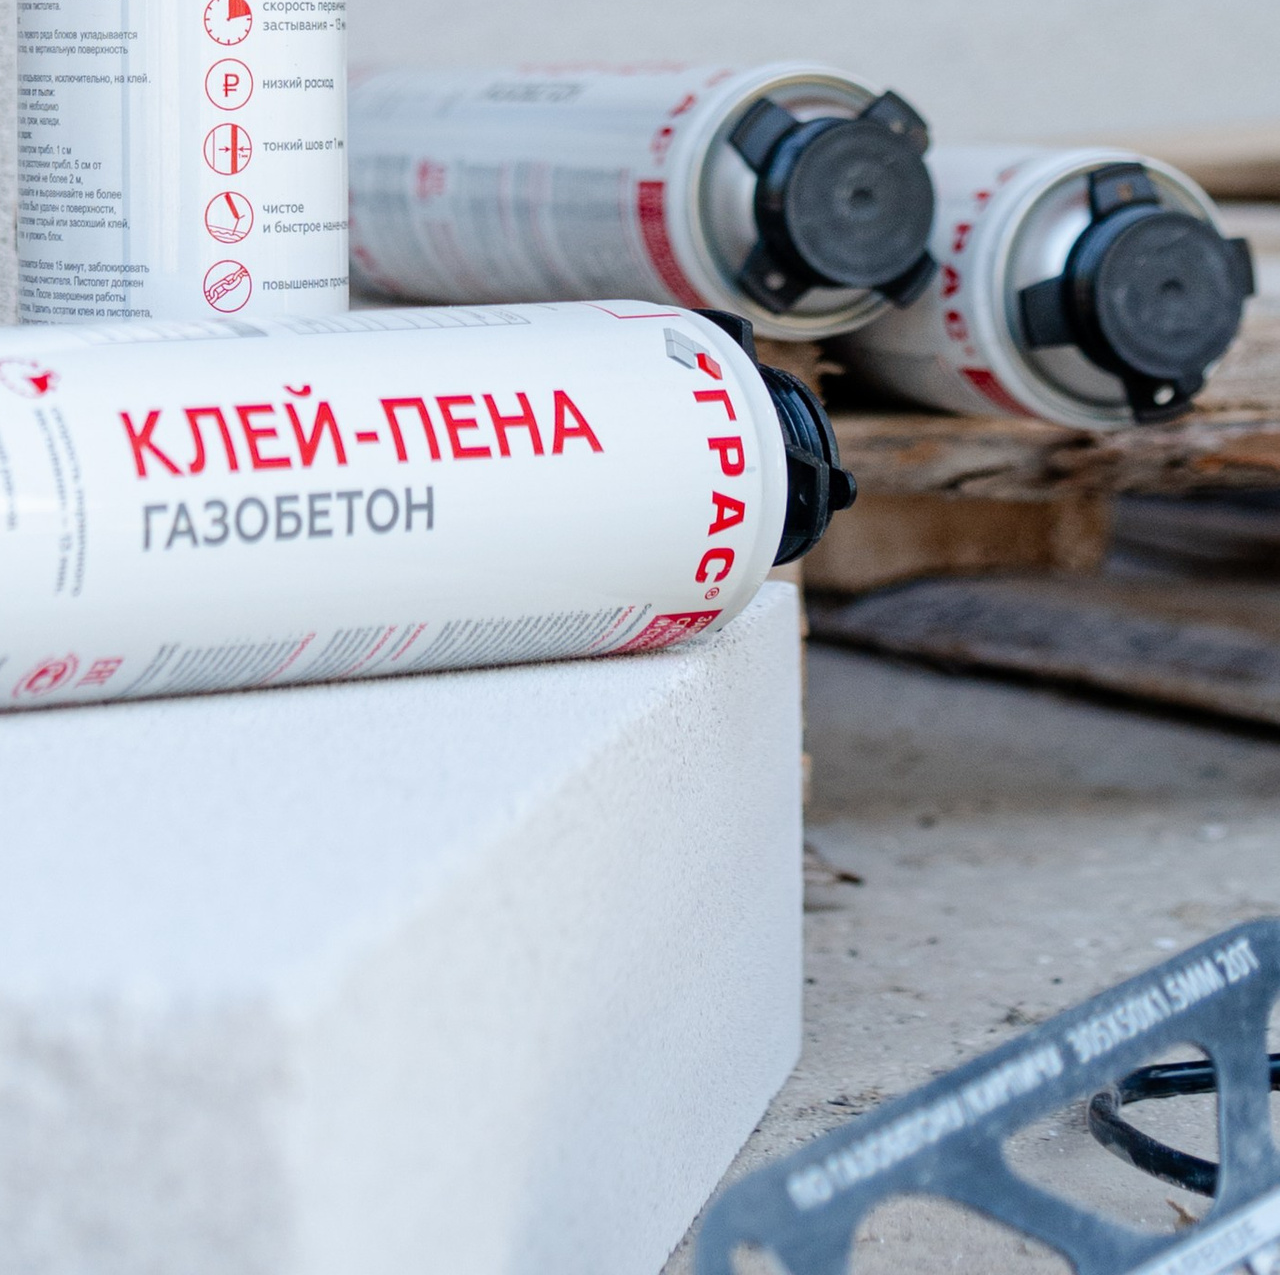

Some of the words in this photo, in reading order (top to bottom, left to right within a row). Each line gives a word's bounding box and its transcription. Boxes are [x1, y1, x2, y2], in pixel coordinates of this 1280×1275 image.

[262, 1, 316, 15] скорость
[263, 19, 328, 32] застывания
[80, 31, 138, 42] укладывается
[77, 45, 129, 56] поверхность
[55, 74, 113, 85] исключительно,
[262, 76, 303, 90] низкий
[304, 78, 335, 92] расход
[262, 139, 303, 152] тонкий
[304, 140, 324, 152] шов
[81, 161, 91, 169] см
[92, 161, 102, 170] от
[96, 188, 122, 200] более
[66, 205, 117, 216] поверхности,
[262, 203, 305, 215] чистое
[69, 217, 106, 229] засохший
[107, 217, 131, 230] клей,
[263, 223, 271, 234] и
[274, 220, 322, 237] быстрое
[64, 261, 87, 274] минут,
[88, 261, 150, 275] заблокировать
[73, 276, 110, 288] Пистолет
[110, 278, 144, 289] должен
[262, 279, 329, 292] повышенная
[52, 291, 94, 303] завершения
[95, 291, 127, 304] работы
[77, 307, 94, 318] клея
[107, 308, 153, 320] пистолета,
[117, 383, 606, 479] КЛЕЙ-ПЕНА
[141, 485, 436, 551] ГАЗОБЕТОН
